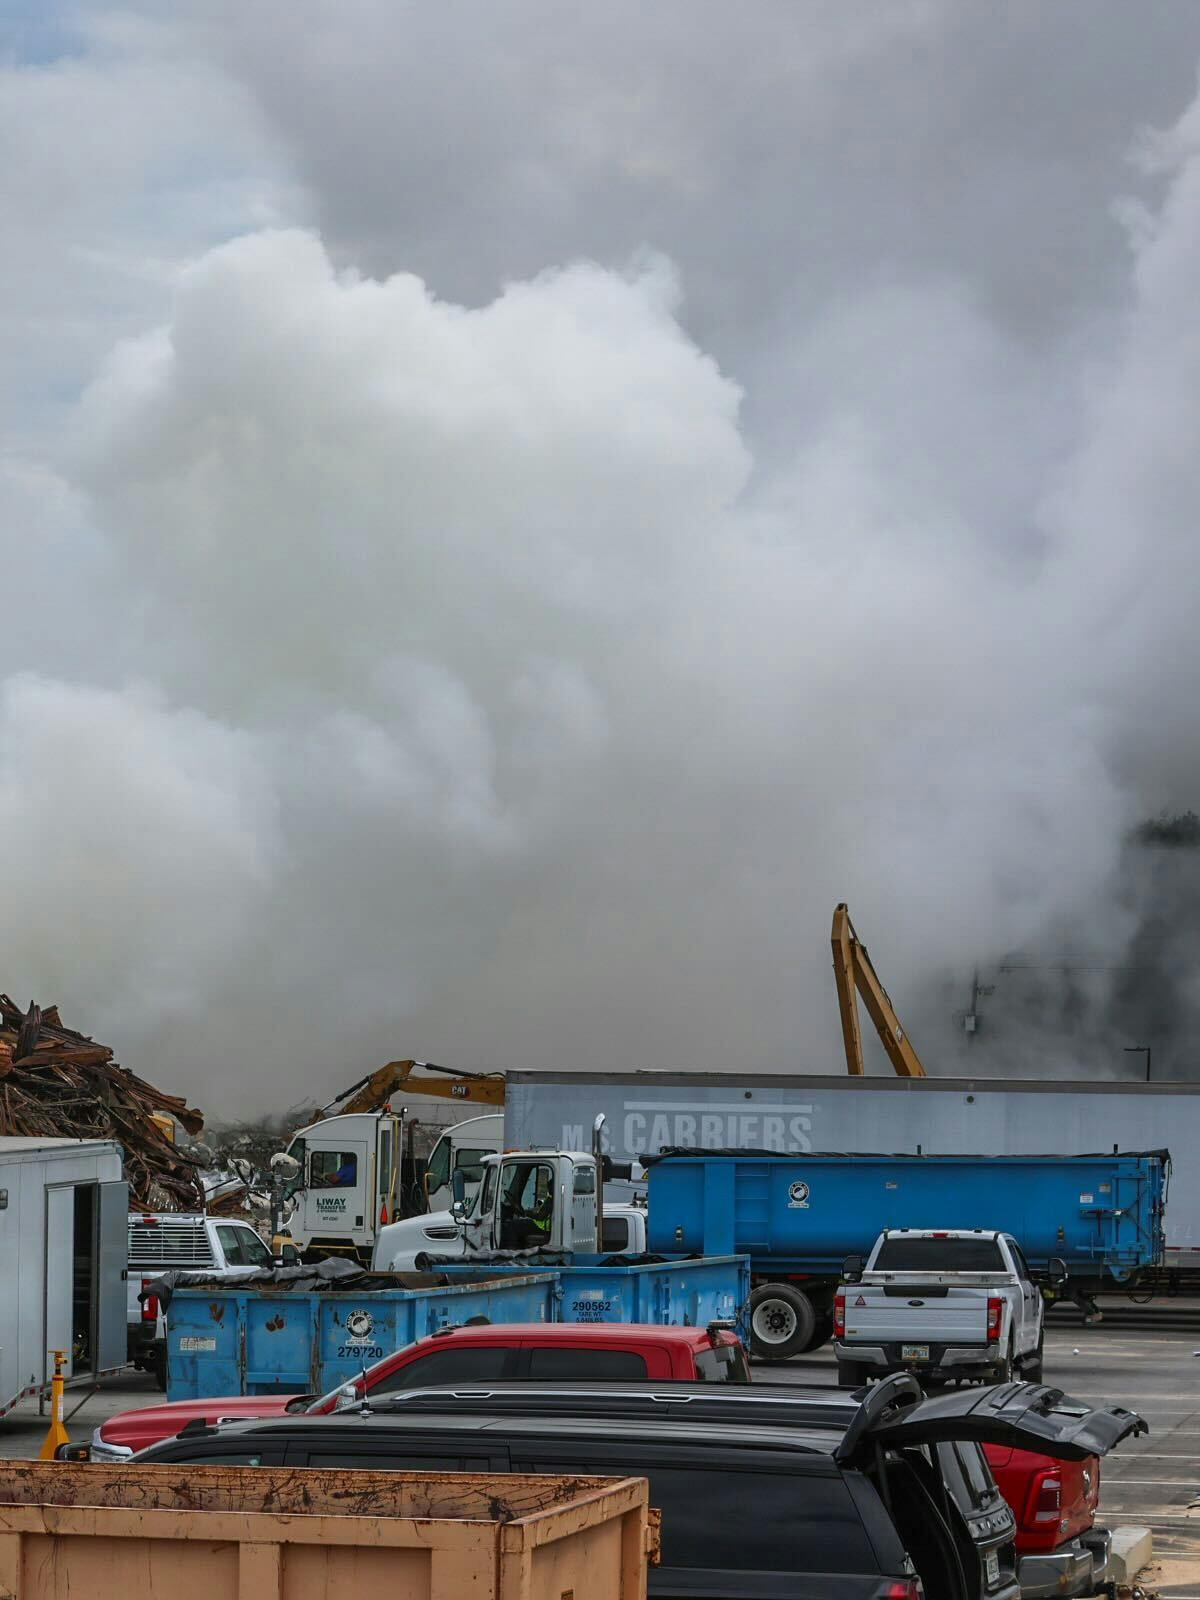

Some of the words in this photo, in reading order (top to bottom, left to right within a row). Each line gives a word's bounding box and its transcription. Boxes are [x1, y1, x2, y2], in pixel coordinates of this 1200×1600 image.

[624, 1112, 812, 1153] CARRIERS
[572, 1301, 611, 1311] 290562
[337, 1346, 383, 1358] 279720
